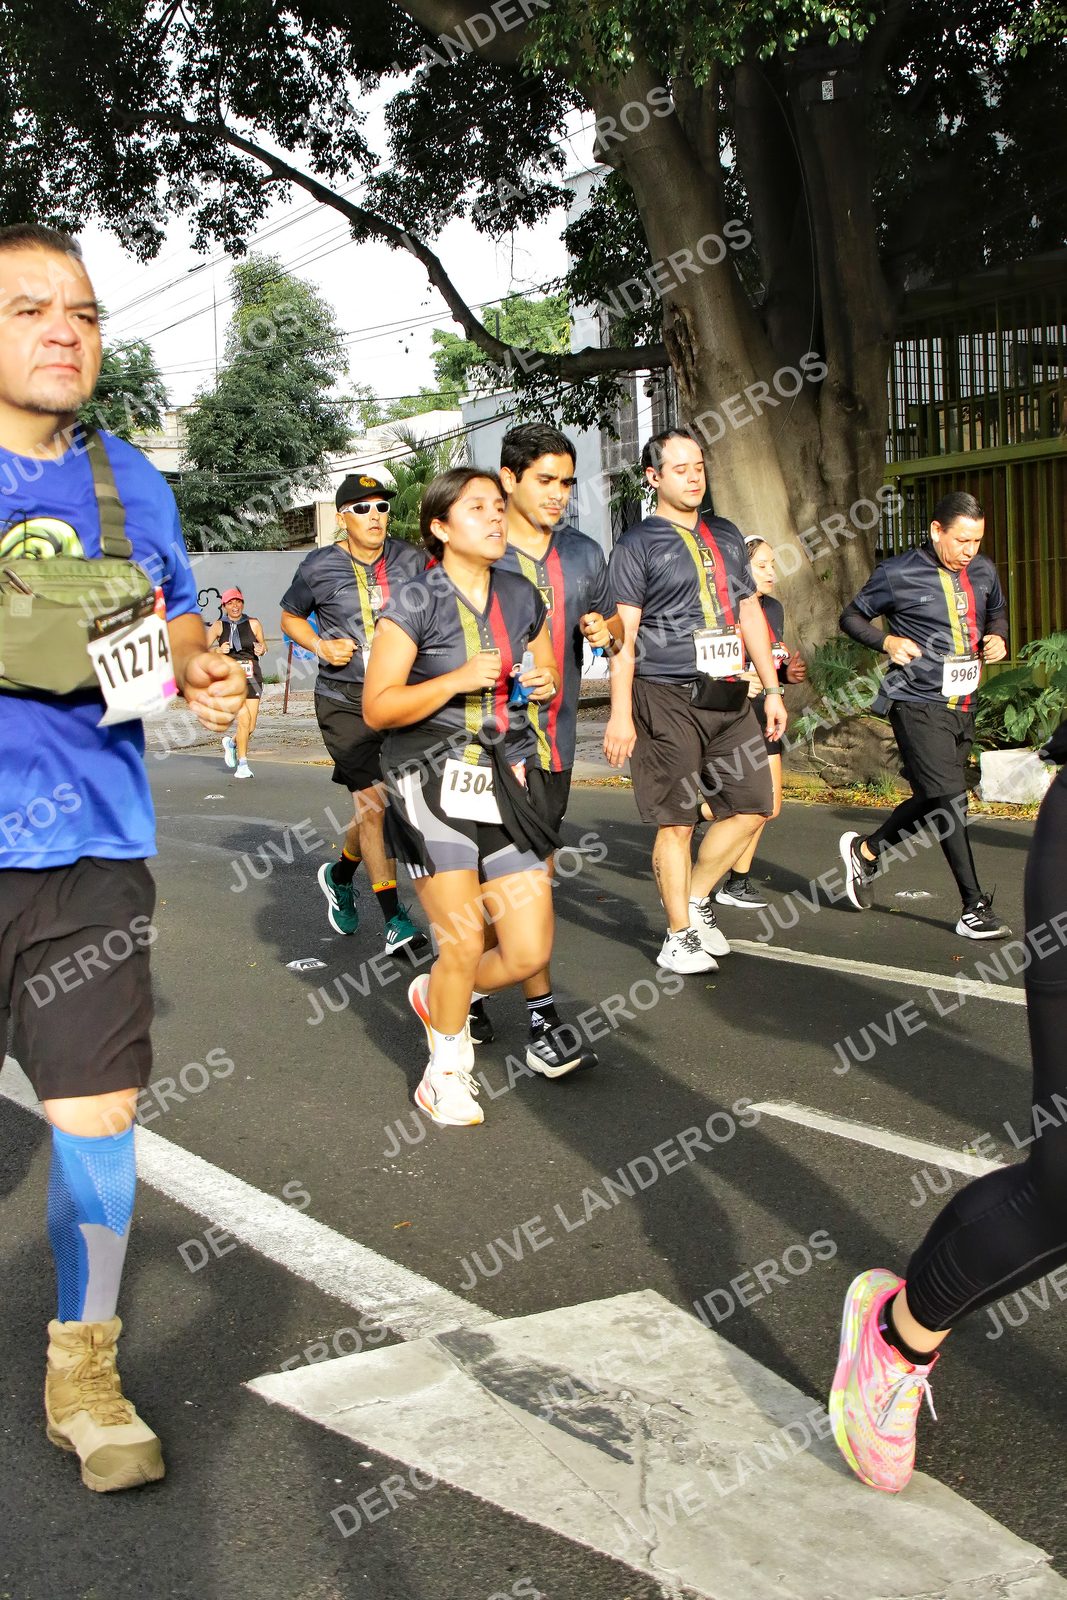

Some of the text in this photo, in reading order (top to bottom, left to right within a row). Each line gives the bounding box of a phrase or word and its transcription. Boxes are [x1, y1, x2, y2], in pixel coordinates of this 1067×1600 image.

[98, 629, 168, 688] 11274
[700, 641, 739, 660] 11476
[951, 666, 977, 682] 9963
